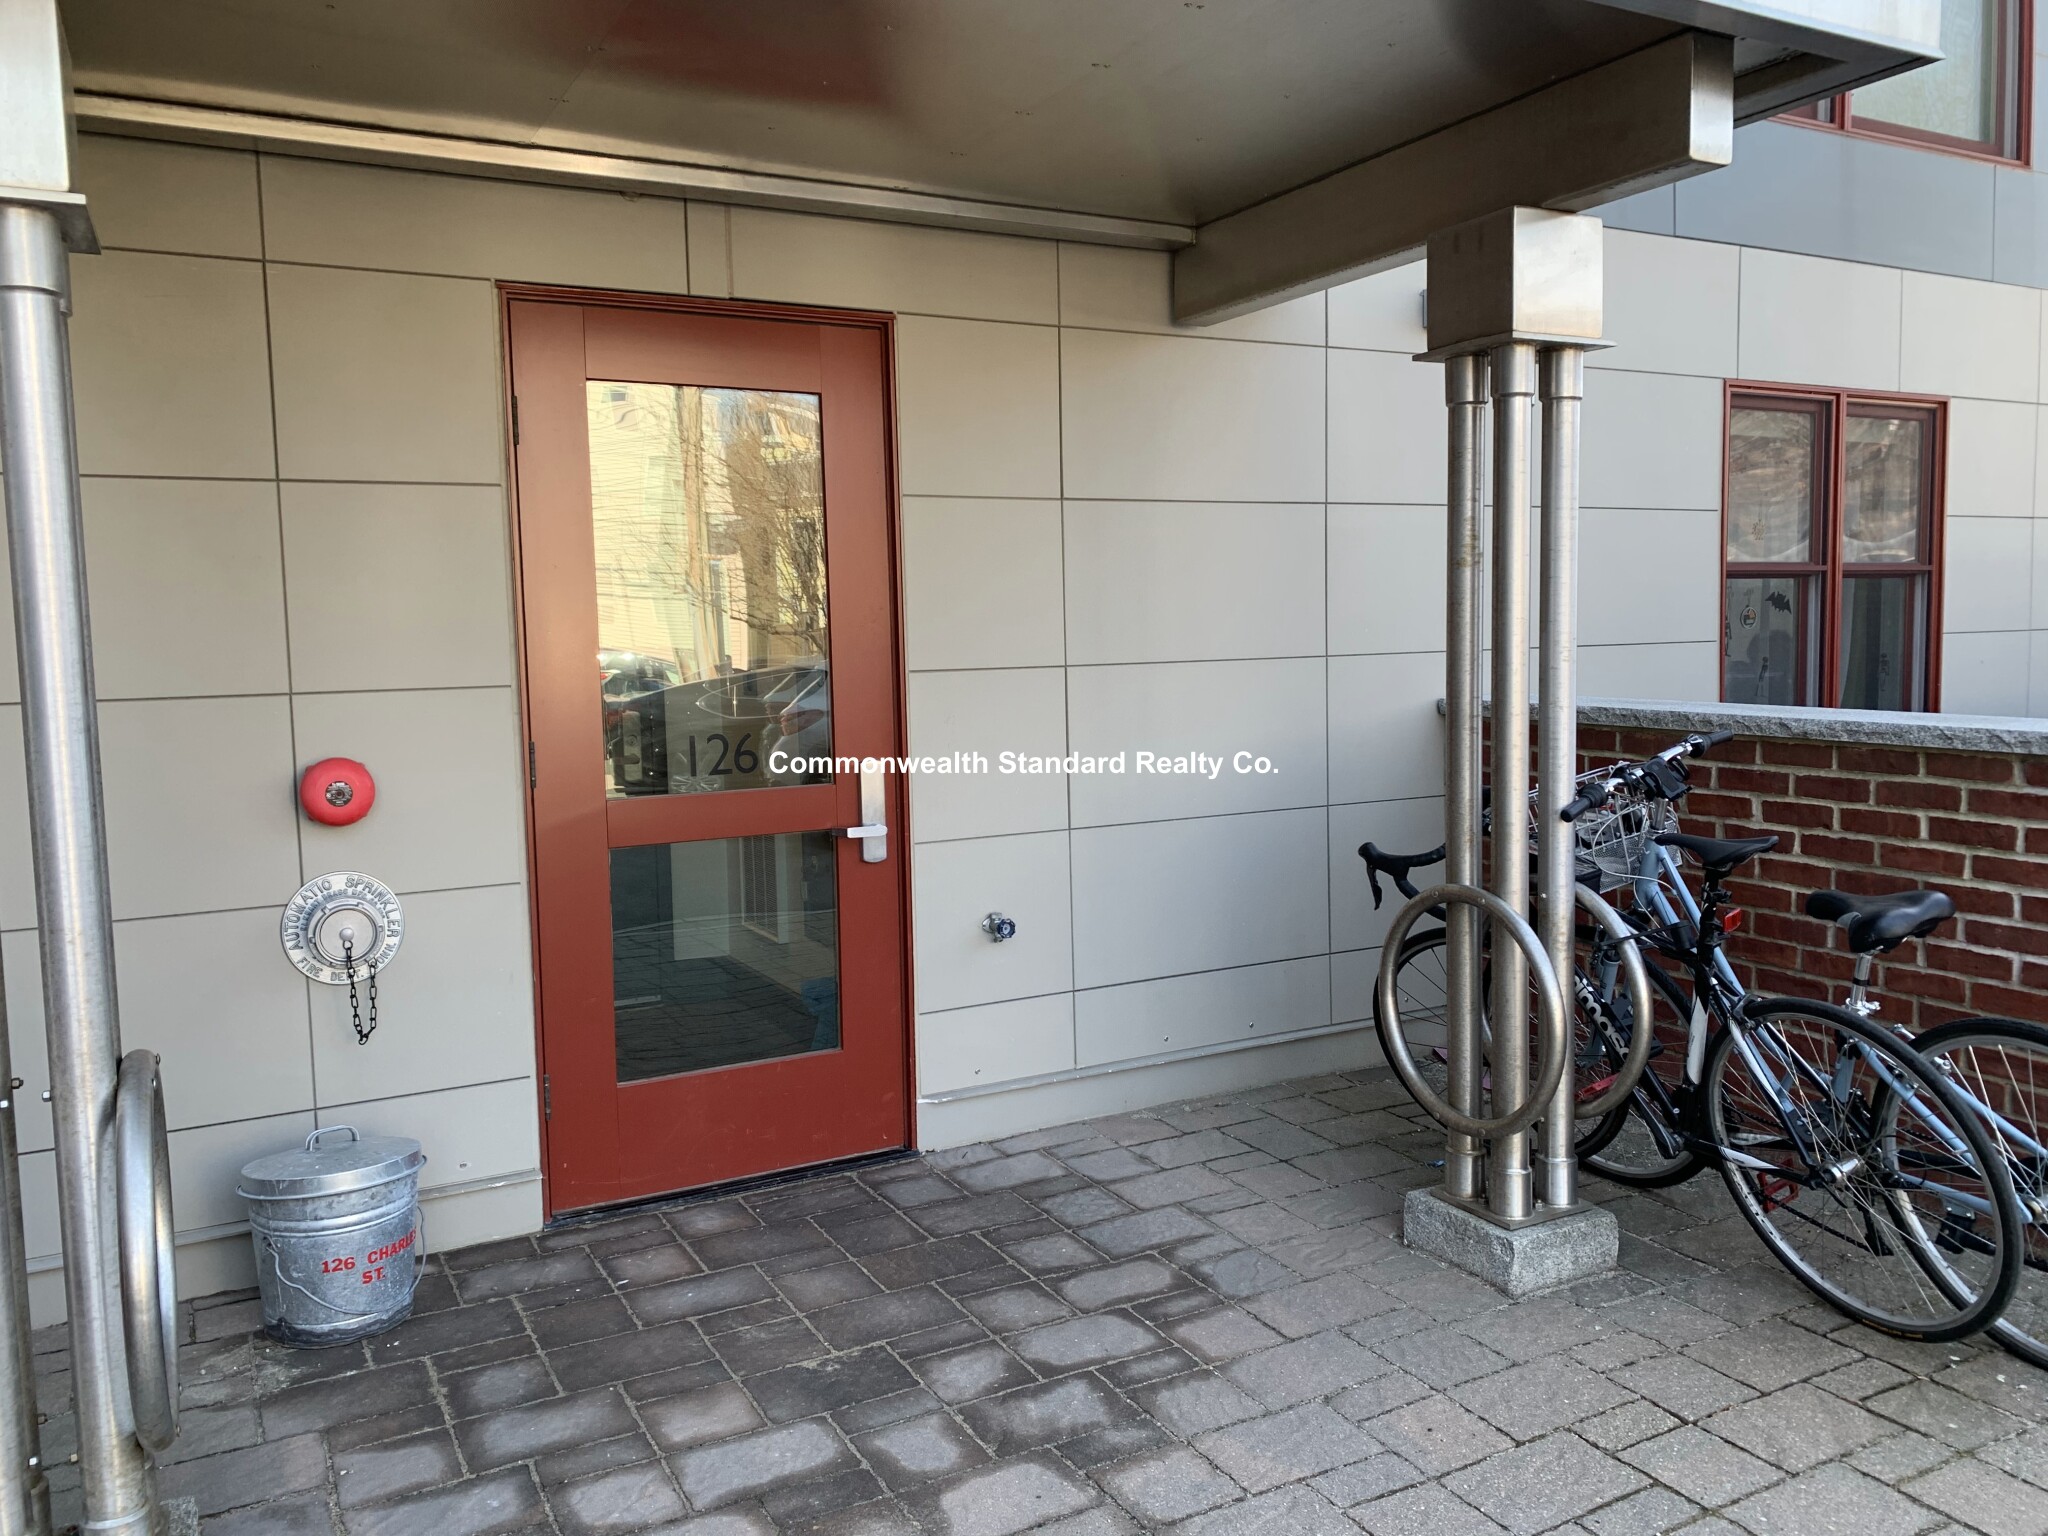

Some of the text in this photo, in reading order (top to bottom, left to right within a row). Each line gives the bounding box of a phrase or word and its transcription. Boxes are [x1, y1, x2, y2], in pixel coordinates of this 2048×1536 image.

[688, 732, 758, 777] 126
[284, 875, 401, 951] AUTOMATIC SPRINKLER
[296, 957, 323, 978] FIRE
[321, 1256, 356, 1274] 126
[362, 1266, 386, 1284] ST.
